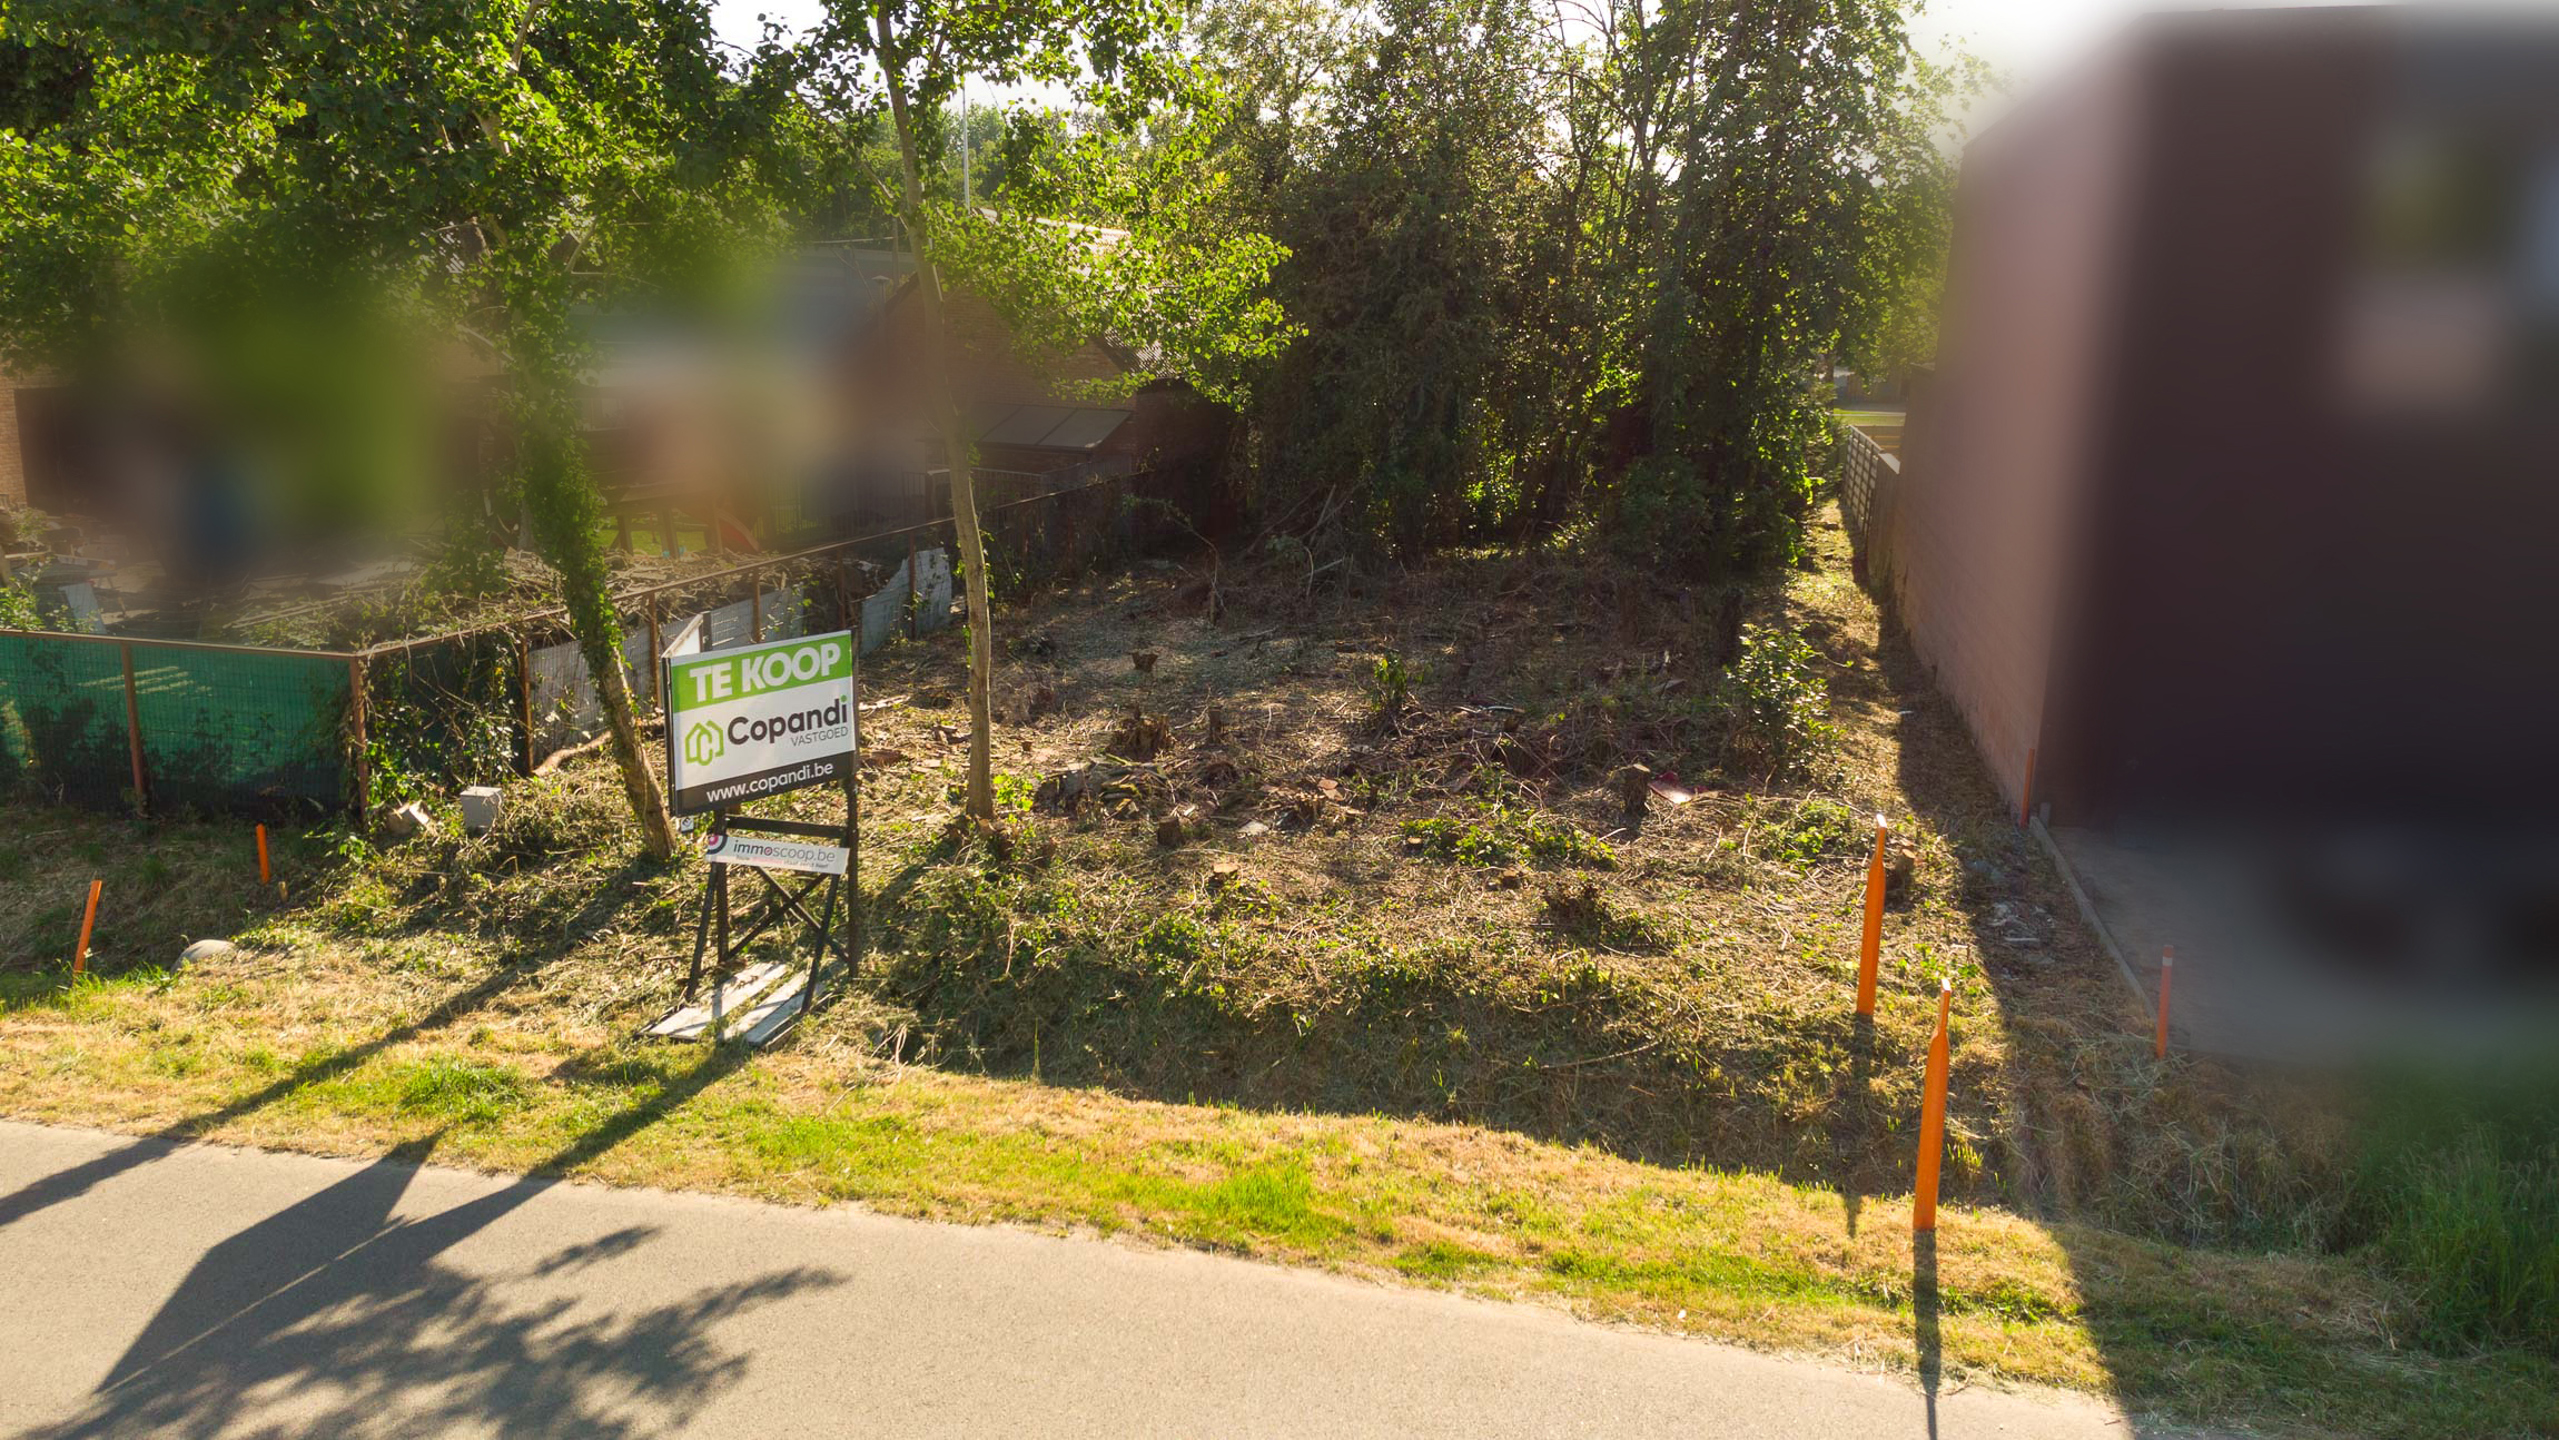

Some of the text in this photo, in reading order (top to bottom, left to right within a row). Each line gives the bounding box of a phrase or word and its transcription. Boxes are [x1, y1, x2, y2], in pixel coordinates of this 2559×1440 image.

[689, 643, 840, 702] TE KOOP
[727, 695, 848, 744] Copandi
[790, 726, 848, 747] VASTGOED
[706, 762, 834, 803] www.copandi.be
[733, 840, 836, 863] immoscoop.be
